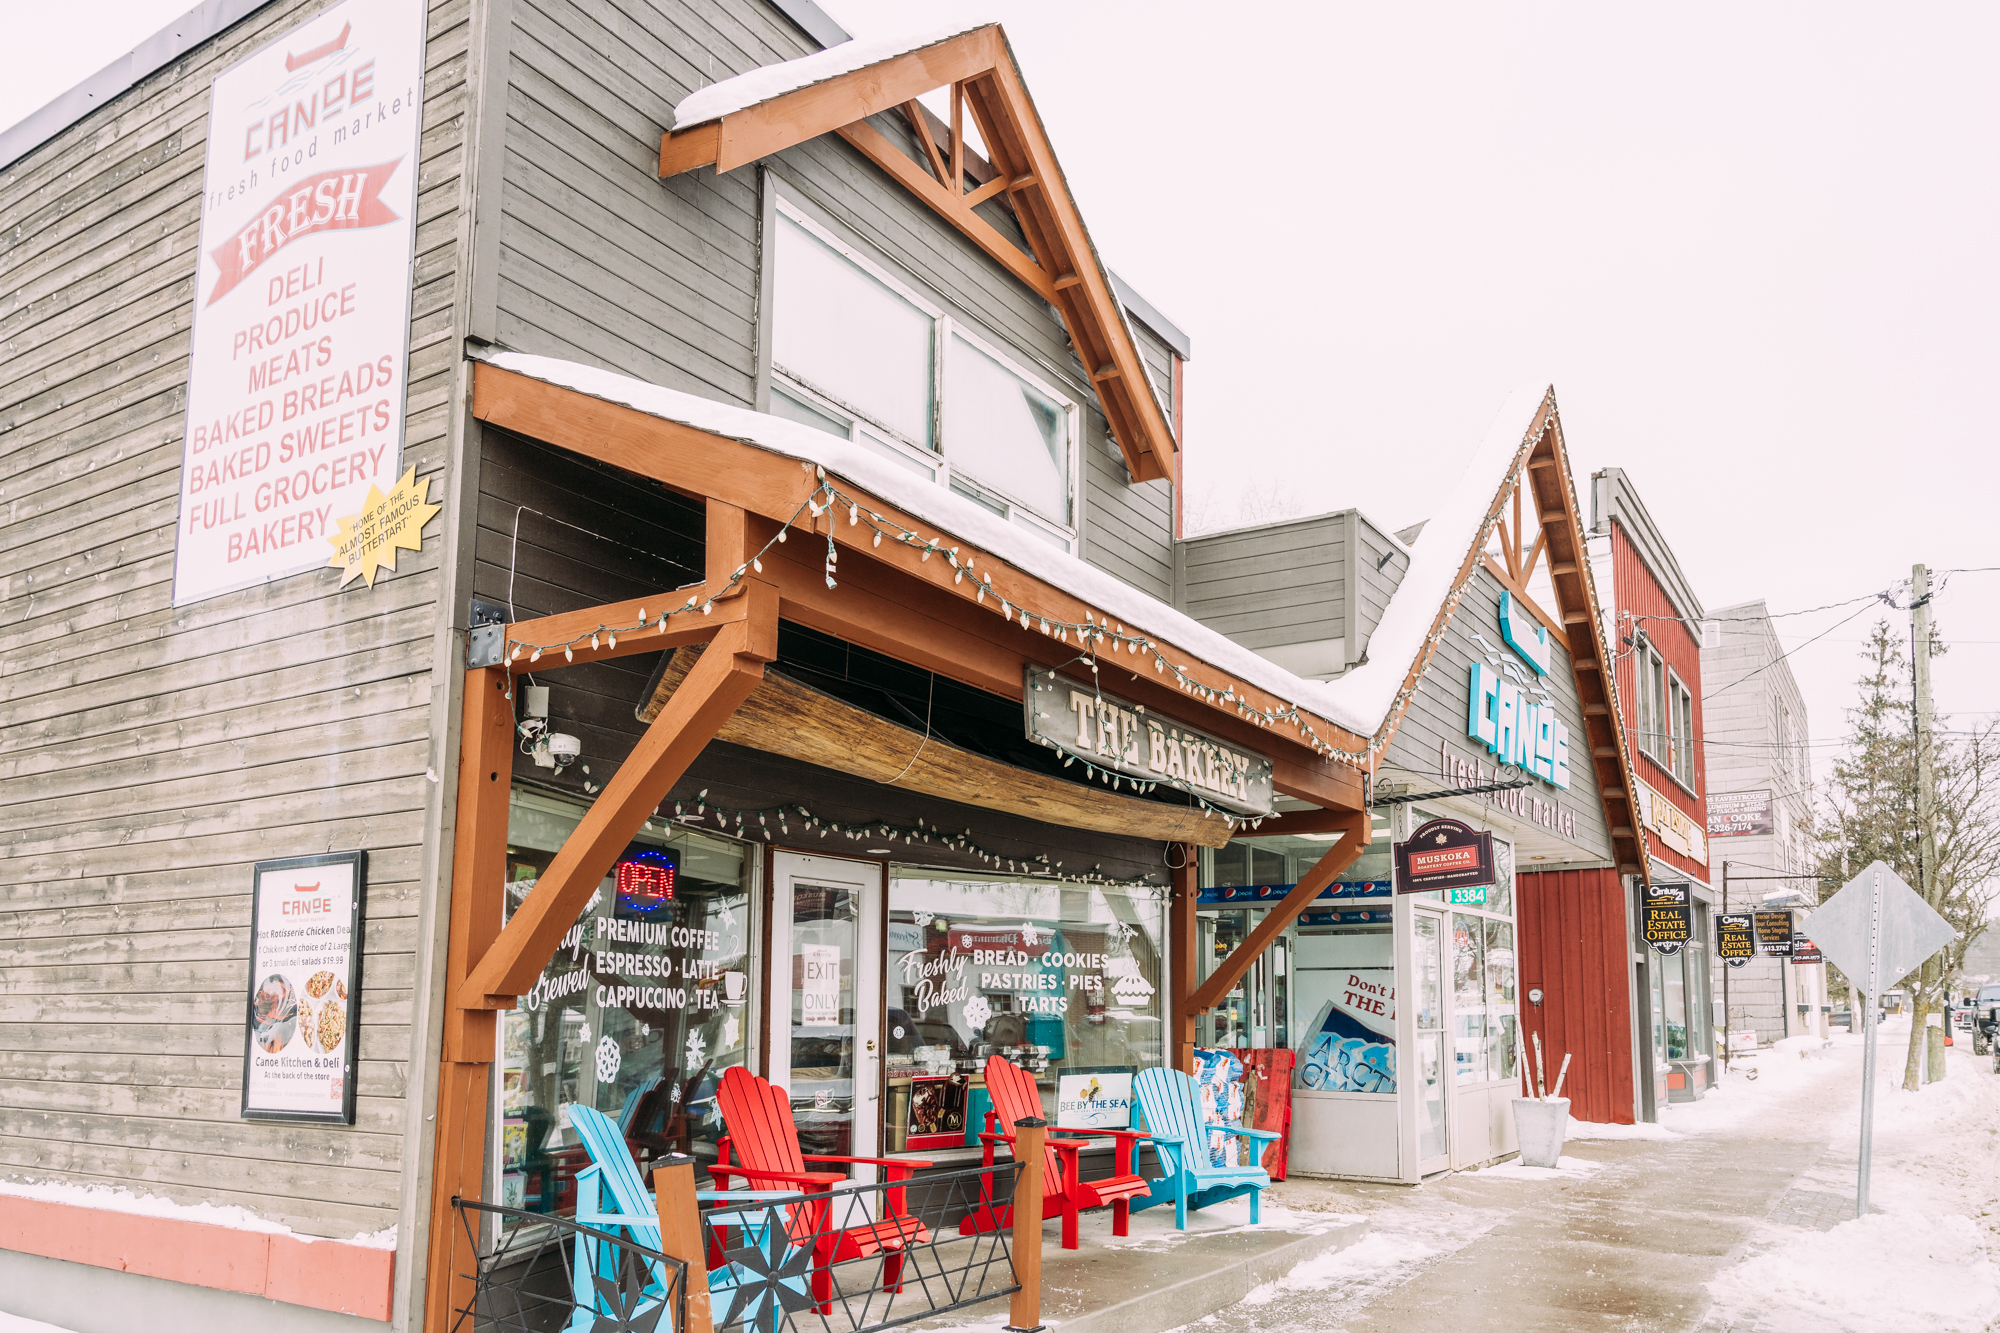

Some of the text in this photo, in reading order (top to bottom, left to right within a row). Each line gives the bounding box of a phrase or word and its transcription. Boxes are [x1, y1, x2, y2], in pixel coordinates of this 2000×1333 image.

[244, 58, 375, 163] CANOE
[209, 87, 414, 211] fresh food market
[238, 173, 368, 271] FRESH
[268, 256, 323, 306] DELI
[233, 283, 355, 360] PRODUCE
[248, 335, 332, 394] MEATS
[193, 355, 393, 455] BAKED BREADS
[190, 399, 390, 495] BAKED SWEETS
[189, 443, 387, 535] FULL GROCERY
[377, 502, 387, 515] OF
[389, 490, 405, 506] THE
[227, 504, 333, 563] BAKERY
[339, 494, 419, 557] ALMOST FAMOUS
[1468, 662, 1570, 790] CANOE
[1070, 690, 1249, 801] THE BAKERY
[1532, 796, 1576, 839] market
[1724, 813, 1762, 823] COOKE
[1707, 823, 1752, 833] 5-326-7174
[1416, 851, 1470, 865] MUSKOKA
[620, 862, 674, 899] OPEN
[1377, 884, 1391, 892] peps
[1238, 889, 1253, 897] pepsi
[1273, 888, 1288, 896] pepsi
[1454, 889, 1484, 903] 3384
[1675, 891, 1684, 901] 21
[282, 898, 331, 915] CANOE
[1651, 910, 1682, 920] REAL
[270, 927, 304, 938] Rotisserie
[306, 925, 335, 936] Chicken
[336, 925, 351, 935] Dea
[597, 916, 667, 946] PREMIUM
[671, 926, 719, 951] COFFEE
[1647, 920, 1686, 930] ESTATE
[1646, 930, 1688, 940] OFFICE
[1724, 934, 1748, 942] REAL
[262, 945, 285, 954] Chicken
[286, 944, 297, 953] and
[298, 943, 318, 952] choice
[320, 942, 327, 951] of
[328, 942, 332, 950] 2
[333, 942, 351, 952] Large
[1721, 941, 1751, 949] ESTATE
[1721, 949, 1752, 957] OFFICE
[301, 957, 321, 966] salads
[322, 956, 344, 965] $19.99
[596, 951, 720, 980] ESPRESSO LATTE
[898, 946, 969, 984] Freshly
[974, 950, 1109, 969] BREAD COOKIES
[807, 962, 837, 979] EXIT
[981, 972, 1102, 991] PASTRIES PIES
[1347, 974, 1387, 997] Don't
[596, 985, 719, 1010] CAPPUCCINO TEA
[805, 994, 838, 1009] ONLY
[914, 976, 969, 1013] Baked
[1343, 990, 1386, 1017] THE
[1019, 997, 1068, 1012] TARTS
[255, 1056, 340, 1068] Canoe Kitchen & Deli
[264, 1071, 330, 1081] At the back of the store
[1060, 1101, 1075, 1112] BEE
[1077, 1101, 1088, 1110] BY
[1091, 1099, 1107, 1109] THE
